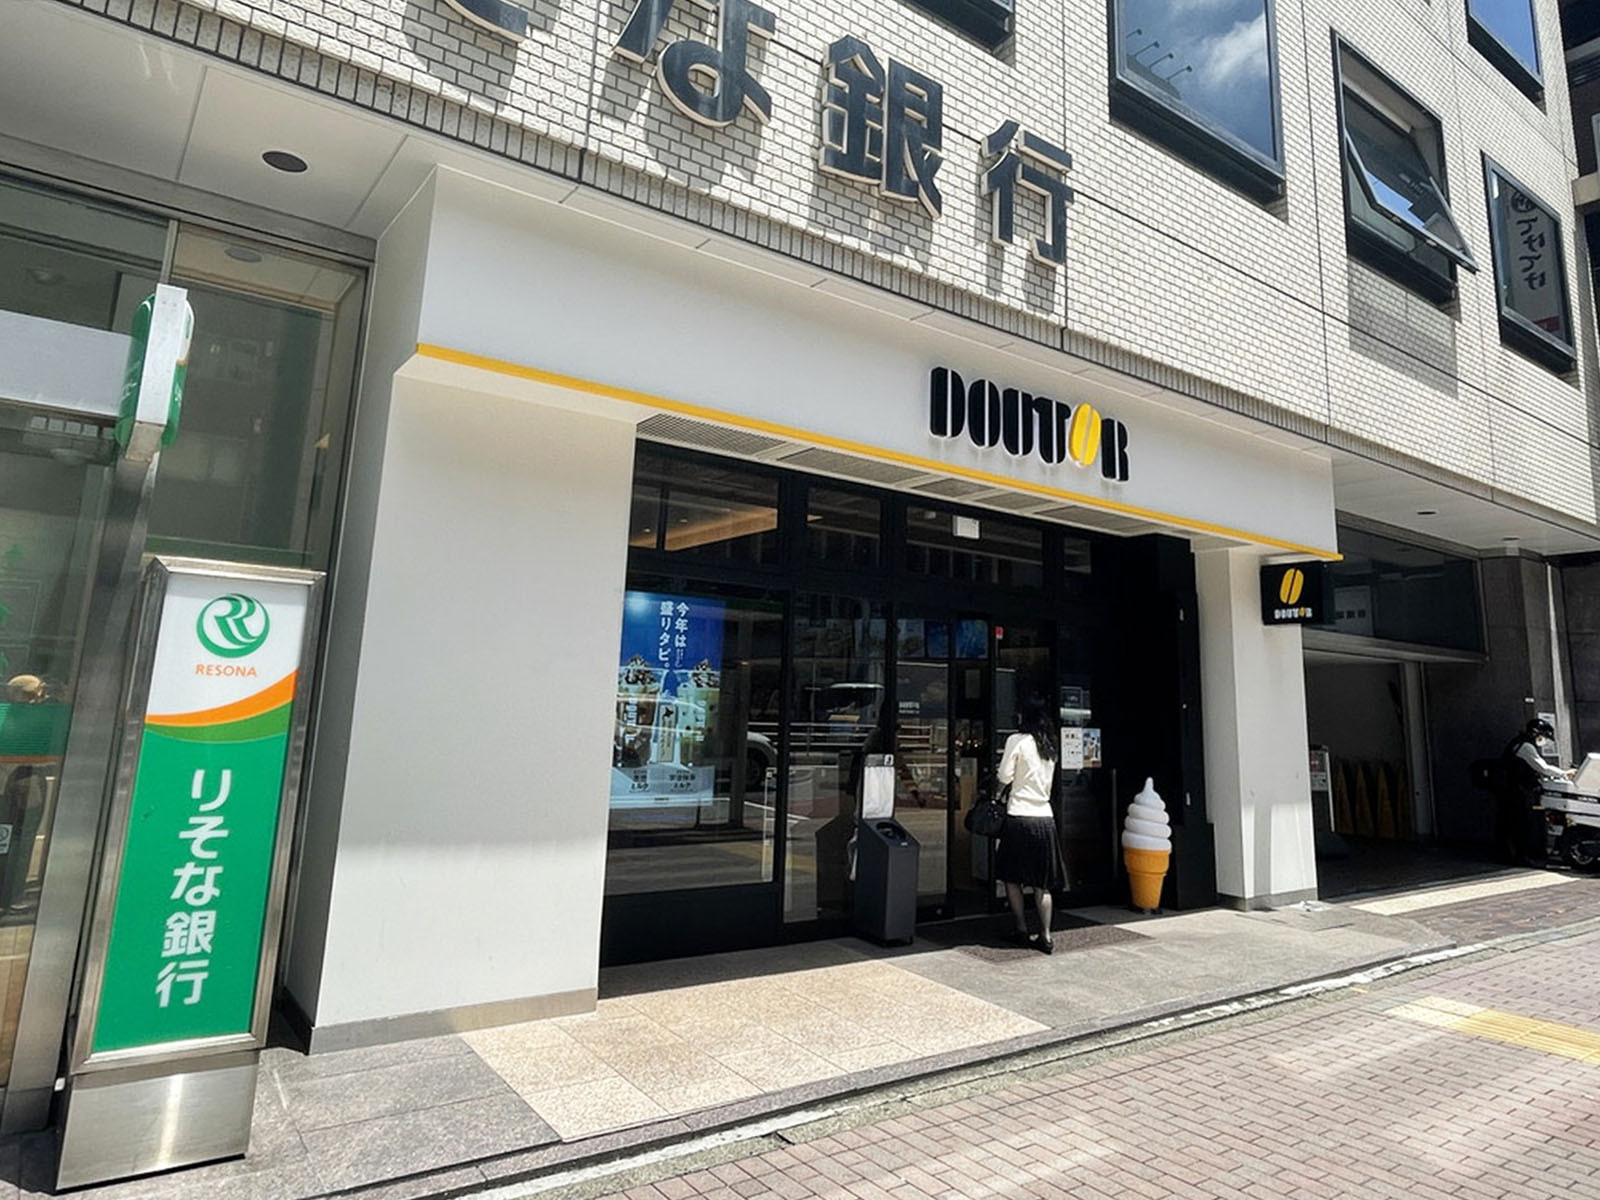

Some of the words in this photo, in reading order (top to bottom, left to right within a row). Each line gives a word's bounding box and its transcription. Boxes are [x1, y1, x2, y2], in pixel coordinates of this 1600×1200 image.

[446, 0, 1074, 268] な銀行
[929, 366, 1129, 482] DOUTOR
[675, 602, 689, 647] 今年は
[1274, 606, 1312, 619] DOUTOR
[195, 664, 257, 678] RESONA
[155, 769, 232, 1008] りそな銀行
